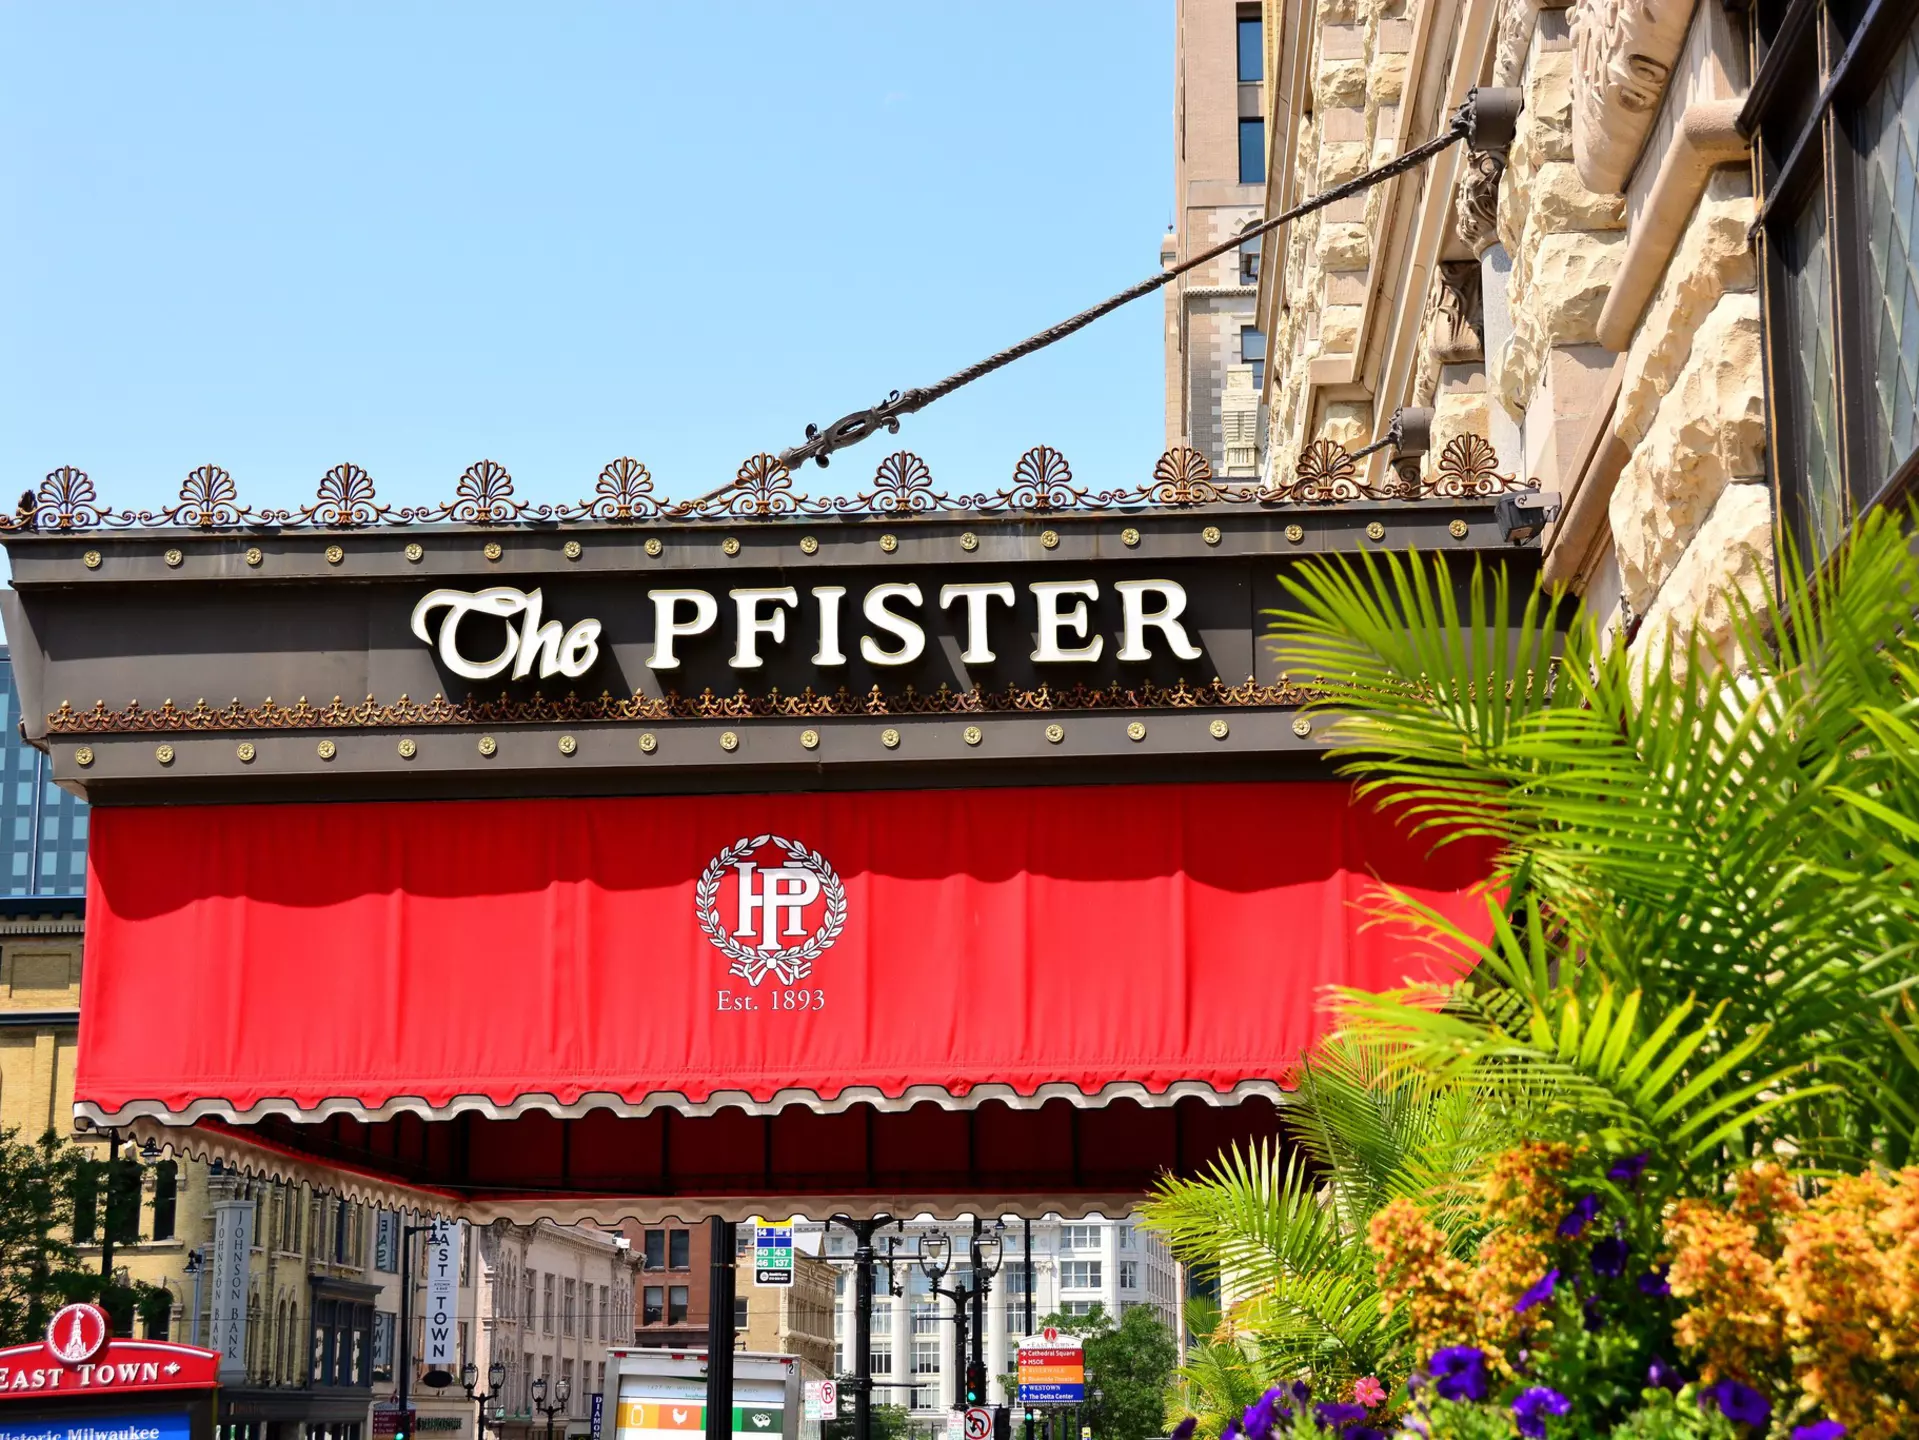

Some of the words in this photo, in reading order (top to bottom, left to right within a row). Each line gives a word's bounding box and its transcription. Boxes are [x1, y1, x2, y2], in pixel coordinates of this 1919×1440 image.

[411, 585, 602, 682] The
[644, 579, 1203, 671] PFISTER
[716, 989, 758, 1011] Est.
[771, 989, 825, 1011] 1893
[757, 1228, 767, 1237] 14
[215, 1211, 225, 1300] JOHNSON
[231, 1210, 244, 1300] JOHNSON
[438, 1219, 450, 1278] EAST
[775, 1248, 787, 1257] 43
[757, 1259, 769, 1267] 46
[775, 1259, 788, 1267] 137
[228, 1307, 239, 1359] BANK
[431, 1296, 450, 1358] TOWN
[1056, 1350, 1076, 1358] Square
[0, 1368, 63, 1389] EAST
[77, 1362, 160, 1387] TOWN
[788, 1364, 794, 1374] 2
[593, 1396, 603, 1440] DIAMON
[67, 1425, 160, 1440] Milwaukee
